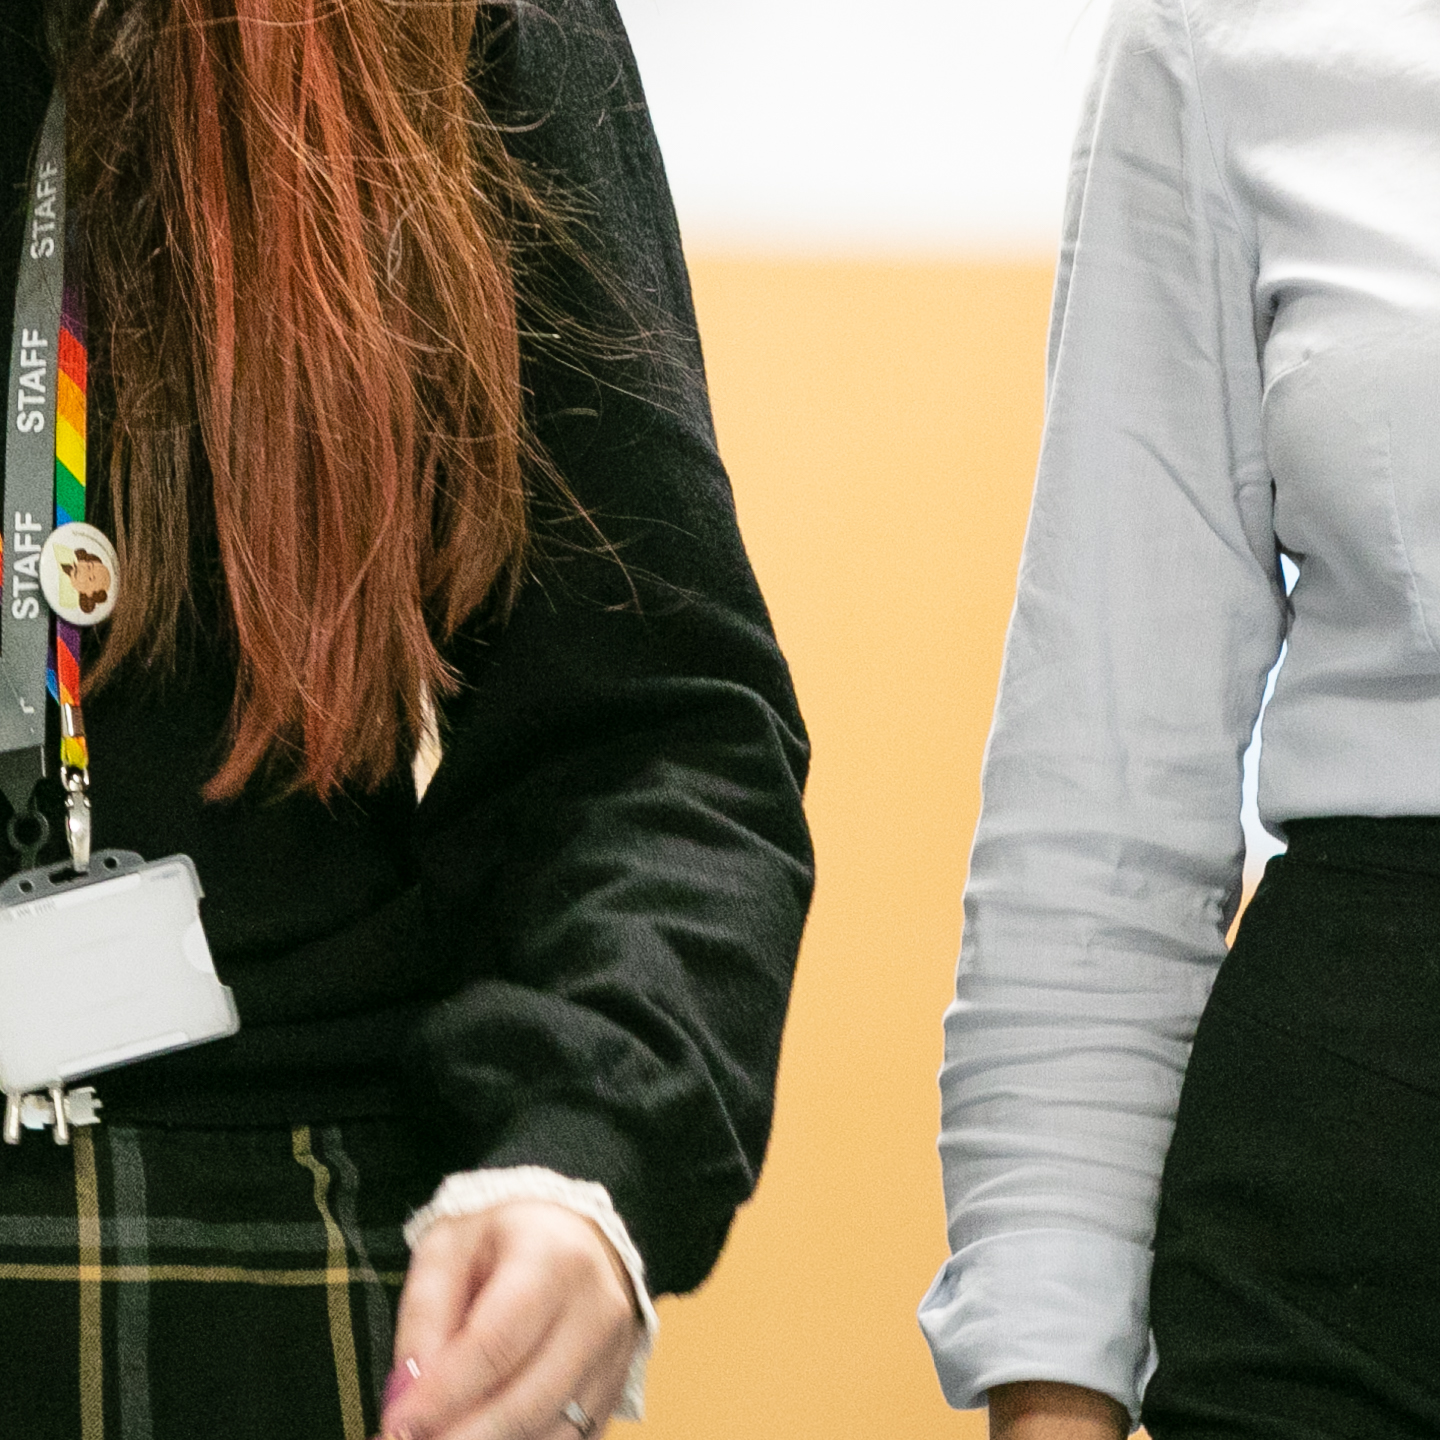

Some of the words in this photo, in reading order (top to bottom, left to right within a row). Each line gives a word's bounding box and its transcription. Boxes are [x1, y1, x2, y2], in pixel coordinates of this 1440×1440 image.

[30, 160, 60, 259] STAFF
[16, 328, 49, 434] STAFF
[12, 511, 43, 620] STAFF
